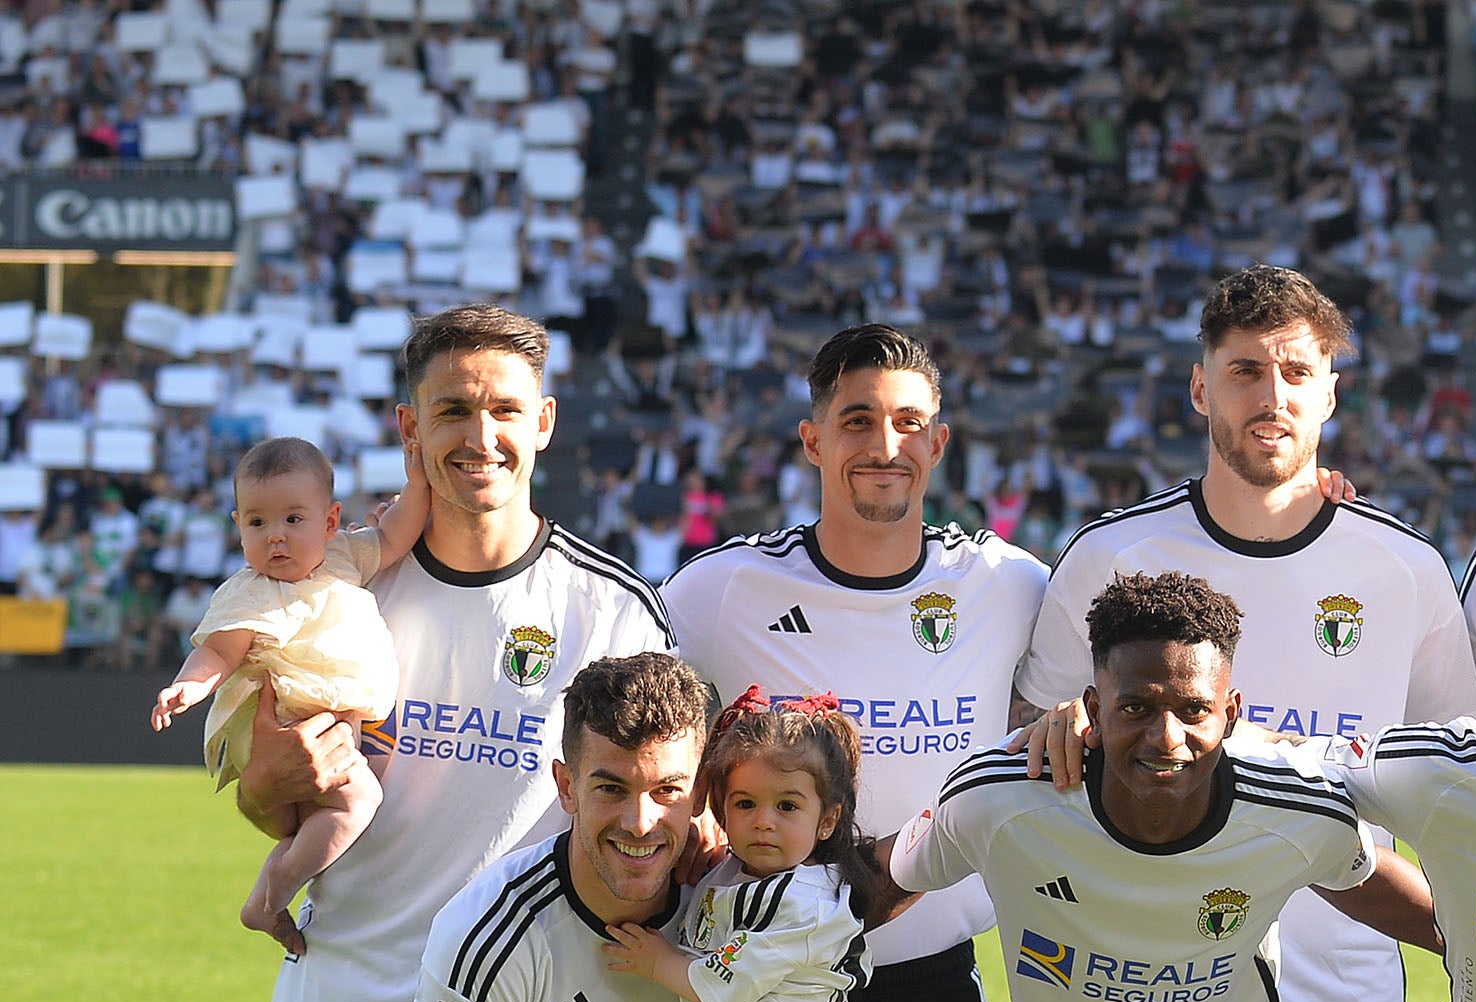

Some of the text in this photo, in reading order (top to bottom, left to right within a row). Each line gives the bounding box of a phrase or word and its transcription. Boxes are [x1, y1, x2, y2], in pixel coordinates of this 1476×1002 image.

[35, 189, 233, 240] Canon
[402, 700, 546, 746] REALE
[837, 695, 977, 728] REALE
[1238, 705, 1363, 740] EALE
[398, 735, 539, 772] SEGUROS
[860, 731, 971, 755] EGUROS
[705, 953, 734, 984] STTA
[1086, 952, 1237, 986] REALE
